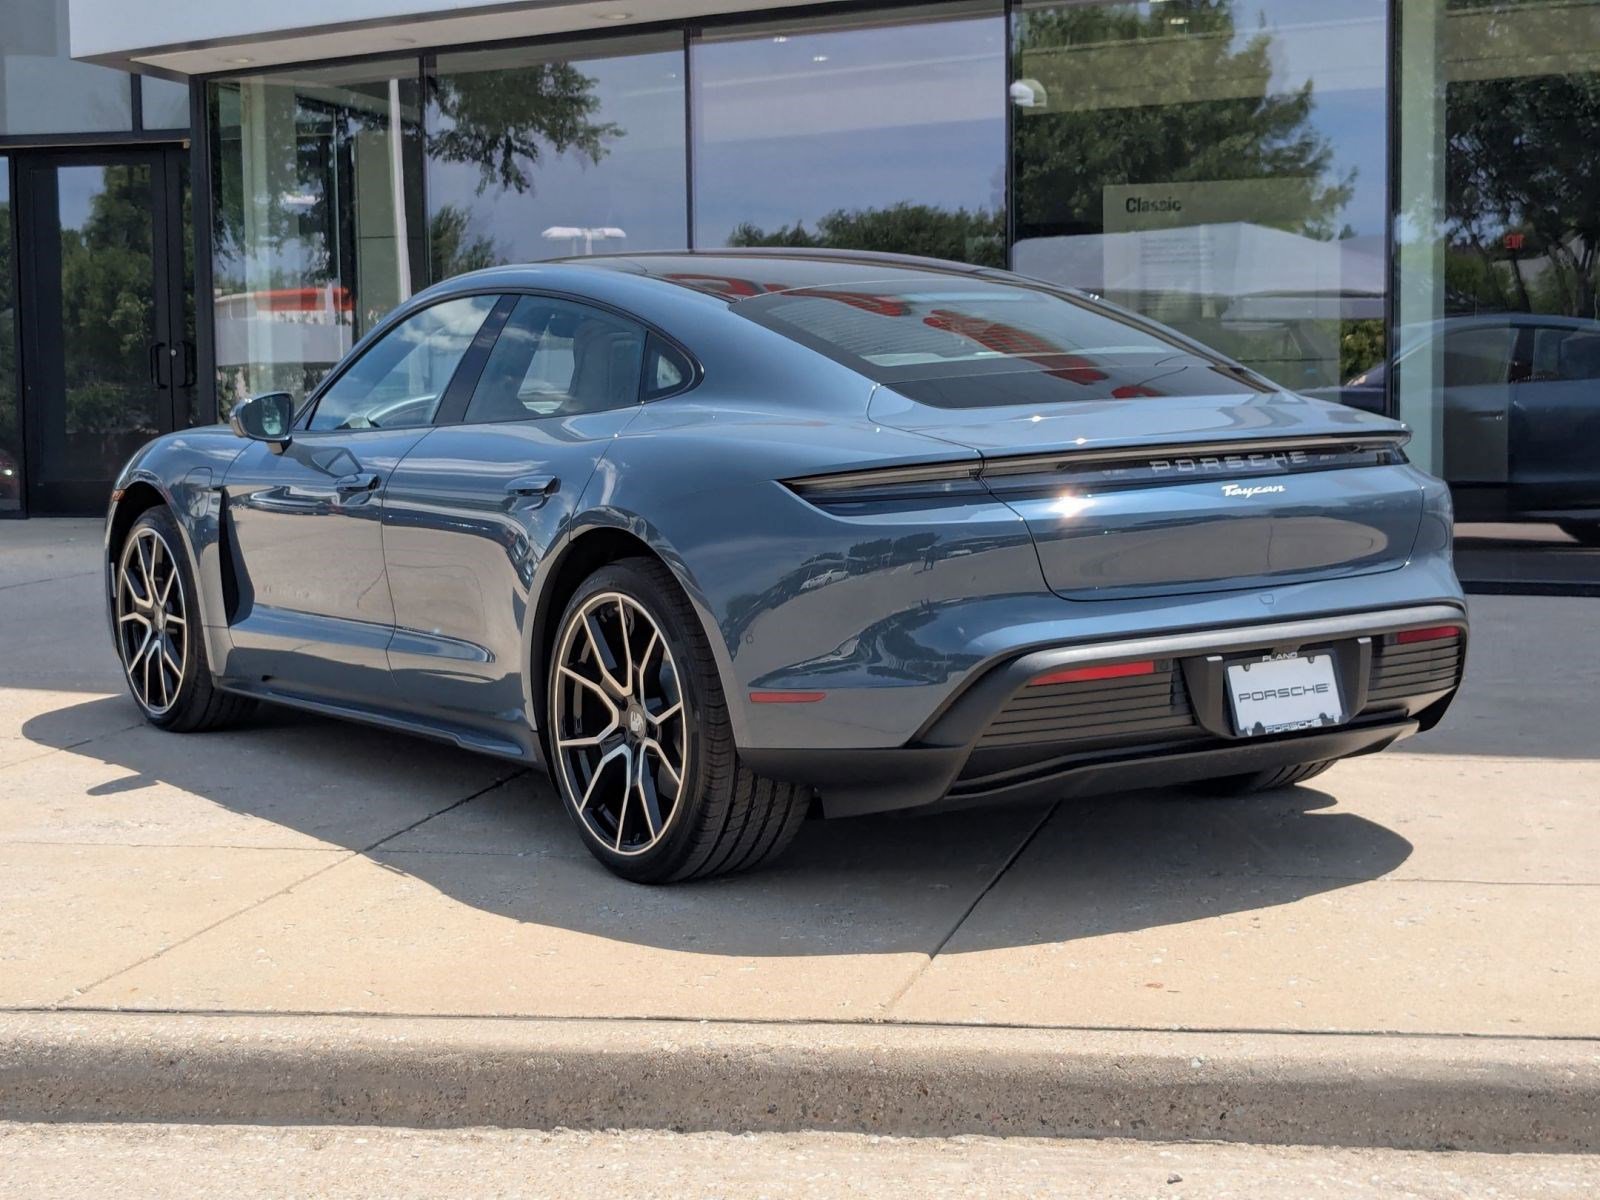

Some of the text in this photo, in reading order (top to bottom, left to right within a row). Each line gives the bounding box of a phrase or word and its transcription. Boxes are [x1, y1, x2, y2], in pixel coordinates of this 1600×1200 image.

[1126, 197, 1181, 213] Classic
[1149, 451, 1308, 472] PORSCHE
[1221, 484, 1286, 498] Taycan
[1238, 683, 1329, 703] PORSCHE
